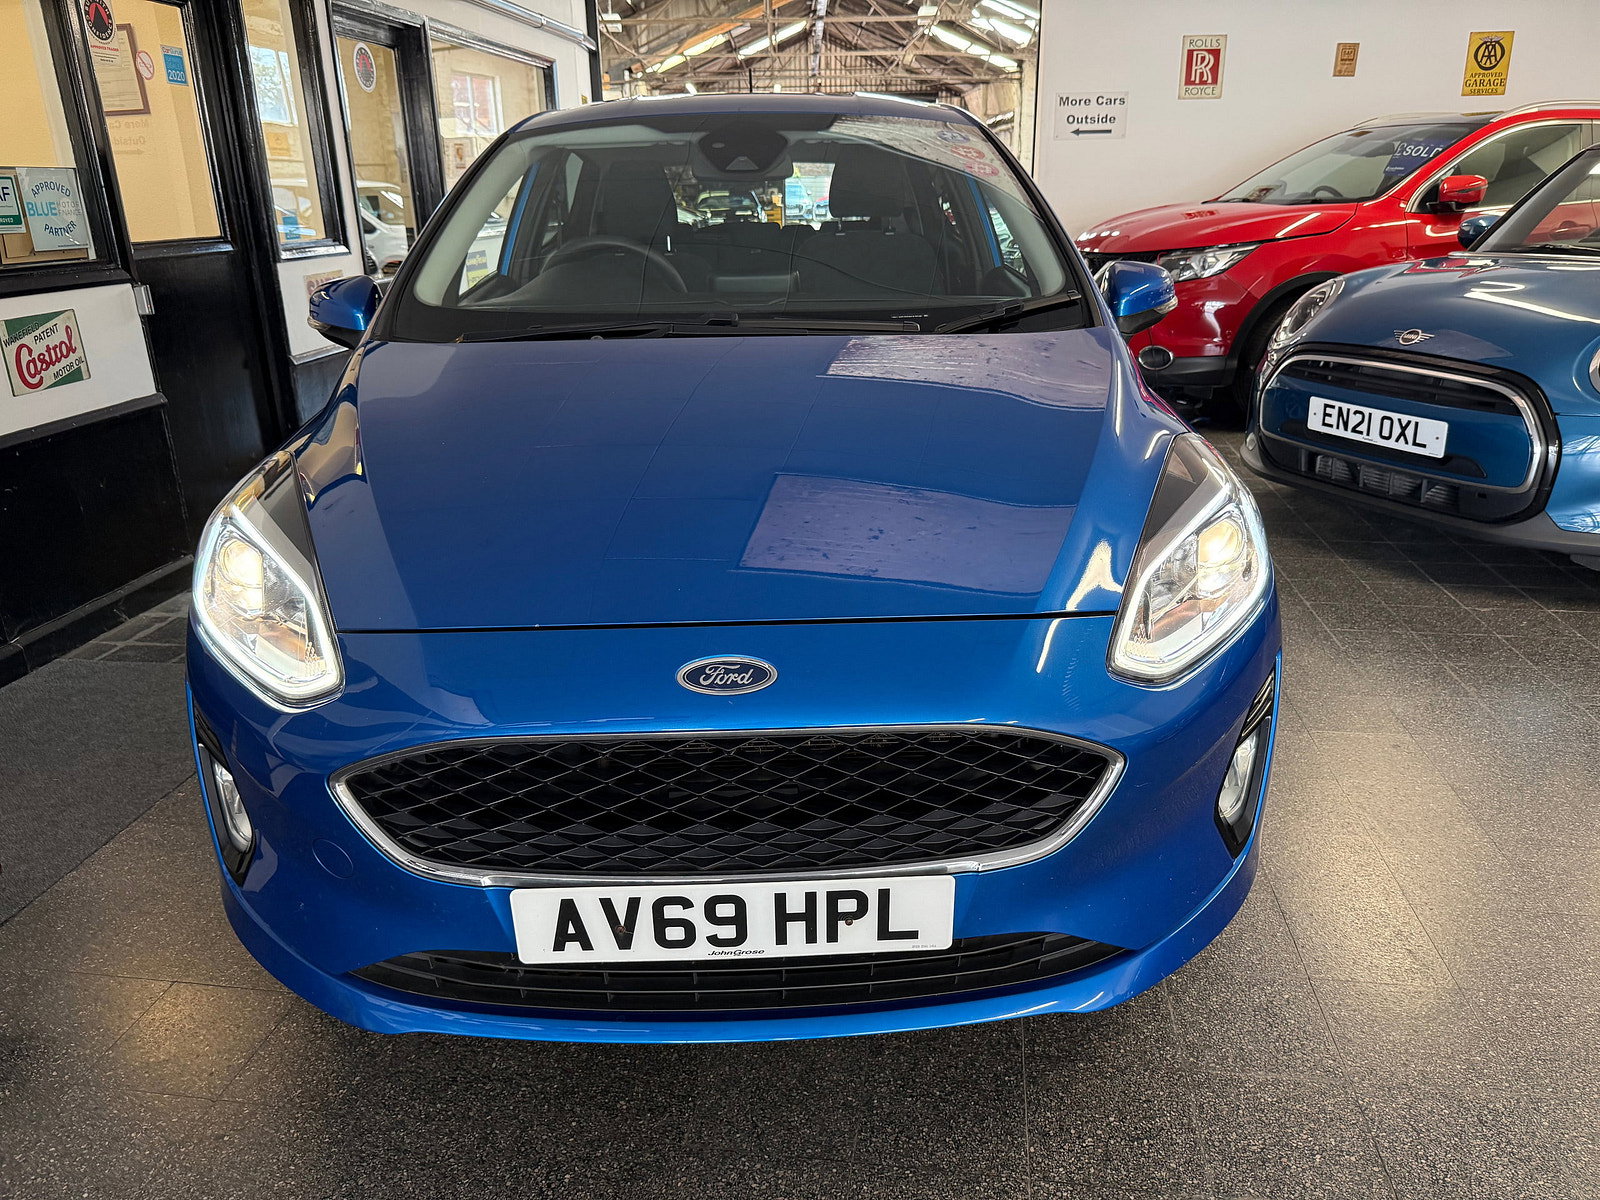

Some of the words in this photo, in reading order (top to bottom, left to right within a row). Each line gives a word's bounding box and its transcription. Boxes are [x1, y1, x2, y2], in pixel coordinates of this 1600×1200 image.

[85, 15, 113, 39] CONFIDENCE
[1188, 38, 1221, 48] ROLLS
[1479, 43, 1498, 66] AA
[167, 70, 186, 82] 2020
[1464, 78, 1506, 88] GARAGE
[1184, 86, 1217, 96] ROYCE
[1059, 96, 1091, 107] More
[1096, 95, 1126, 106] Cars
[1066, 113, 1116, 125] Outside
[31, 181, 71, 198] APPROVED
[25, 201, 58, 217] BLUE
[44, 220, 77, 237] PARTNER
[3, 322, 40, 348] WAKEFIELD
[33, 323, 59, 345] PATENT
[15, 325, 77, 390] Castrol
[53, 361, 75, 380] MOTOR
[74, 356, 85, 367] OIL
[1321, 403, 1373, 437] EN21
[1378, 415, 1427, 449] OXL
[699, 663, 753, 686] Ford
[552, 894, 748, 952] AV69
[774, 887, 919, 947] HPL
